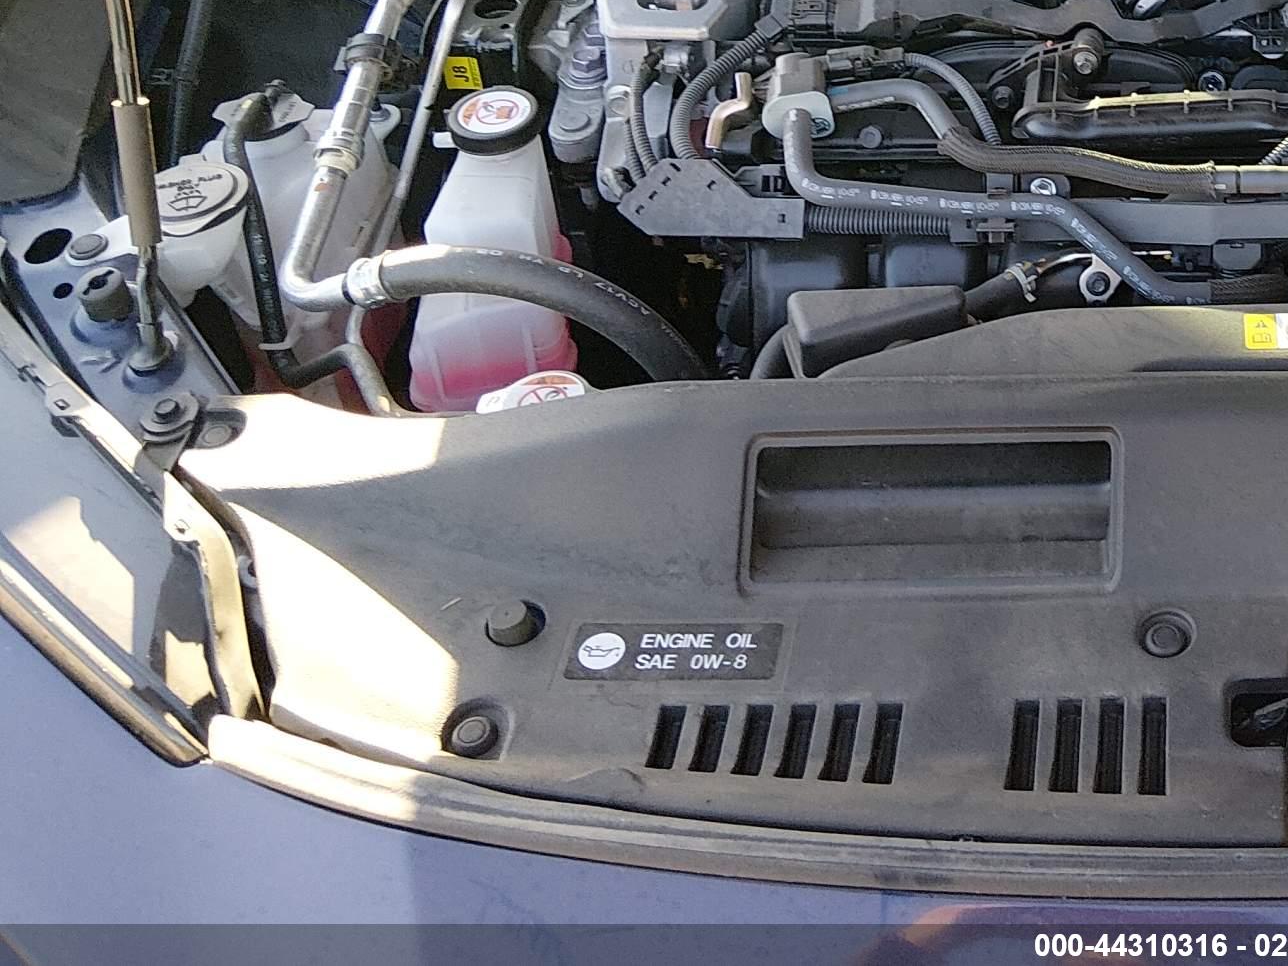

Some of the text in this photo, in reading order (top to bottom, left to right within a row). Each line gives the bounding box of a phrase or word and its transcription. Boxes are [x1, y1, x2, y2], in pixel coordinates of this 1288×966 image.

[452, 65, 469, 82] J8
[639, 633, 758, 649] ENGINE OIL
[634, 654, 748, 670] SAE 0W-8
